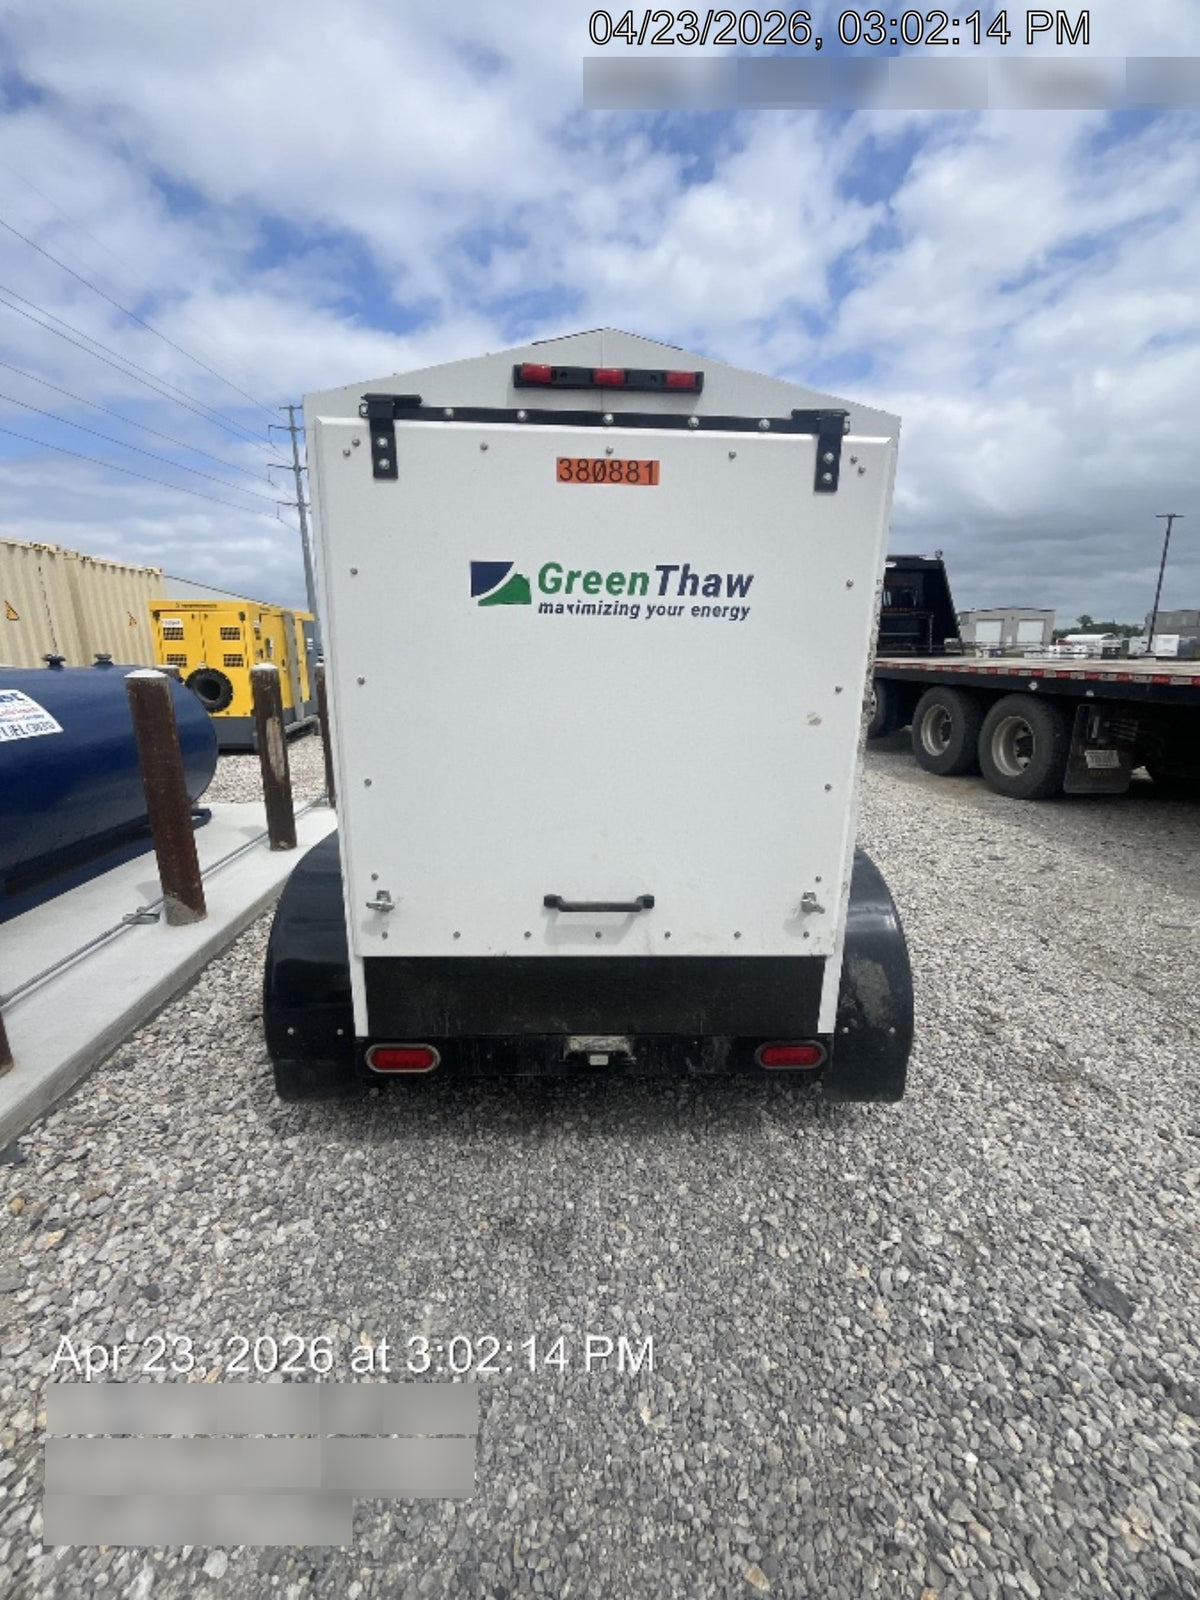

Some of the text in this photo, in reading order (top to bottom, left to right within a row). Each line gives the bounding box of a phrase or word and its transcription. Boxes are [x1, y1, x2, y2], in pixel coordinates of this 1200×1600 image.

[558, 458, 654, 484] 380881
[538, 601, 750, 621] maximizing your energy
